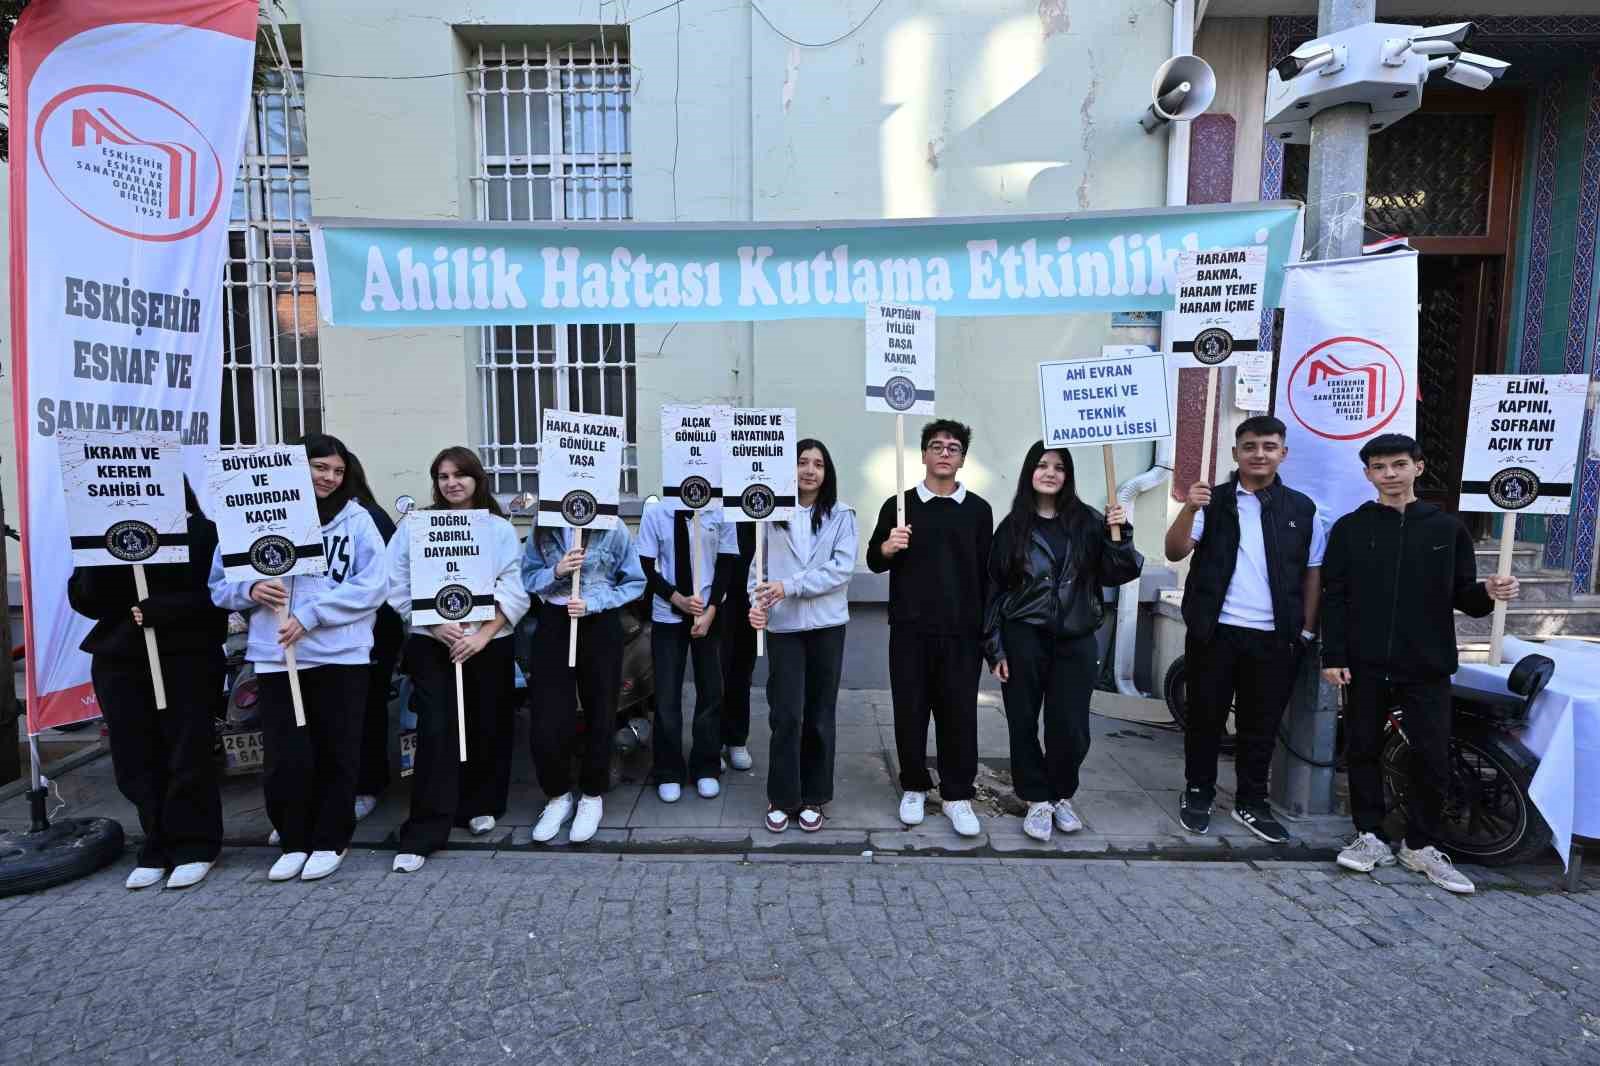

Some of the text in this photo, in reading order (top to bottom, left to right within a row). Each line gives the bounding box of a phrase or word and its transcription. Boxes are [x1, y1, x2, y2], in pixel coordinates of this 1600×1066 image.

[76, 160, 163, 190] SANATKARLAR
[107, 159, 163, 181] ESNAF VE
[112, 180, 163, 198] ODALARI
[135, 206, 162, 218] 1952
[1196, 251, 1246, 265] HARAMA
[360, 245, 529, 312] Ahilik
[540, 246, 722, 308] Haftası
[736, 244, 954, 307] Kutlama
[1180, 283, 1257, 298] HARAM YEME
[65, 277, 200, 336] ESKİŞEHİR
[880, 306, 920, 320] YAPTIĞIN
[1180, 298, 1255, 314] HARAM İÇME
[888, 338, 912, 350] BAŞA
[73, 340, 192, 389] ESNAF VE
[884, 352, 917, 365] KAKMA
[1066, 364, 1132, 380] AHİ EVRAN
[1063, 384, 1138, 401] MESLEKİ VE
[1078, 404, 1126, 420] TEKNİK
[1498, 400, 1552, 414] KAPINI,
[681, 417, 711, 428] ALÇAK
[734, 412, 782, 426] İŞİNDE VE
[1490, 418, 1555, 432] SOFRANI
[546, 420, 580, 434] HAKLA
[1053, 418, 1157, 440] ANADOLU LİSESİ
[675, 430, 716, 442] GÖNÜLLÜ
[730, 430, 784, 441] HAYATINDA
[84, 443, 160, 460] İKRAM VE
[560, 437, 606, 452] GÖNÜLLE
[690, 446, 702, 457] OL
[732, 444, 783, 457] GÜVENİLİR
[1488, 438, 1554, 452] AÇIK TUT
[222, 453, 292, 472] BÜYÜKLÜK
[569, 454, 595, 468] YAŞA
[752, 461, 764, 472] OL
[97, 465, 152, 478] KEREM
[252, 474, 269, 487] VE
[88, 481, 165, 497] SAHİBİ OL
[225, 488, 300, 508] GURURDAN
[246, 508, 288, 524] KAÇIN
[424, 545, 480, 558] DAYANIKLI
[446, 562, 460, 572] OL
